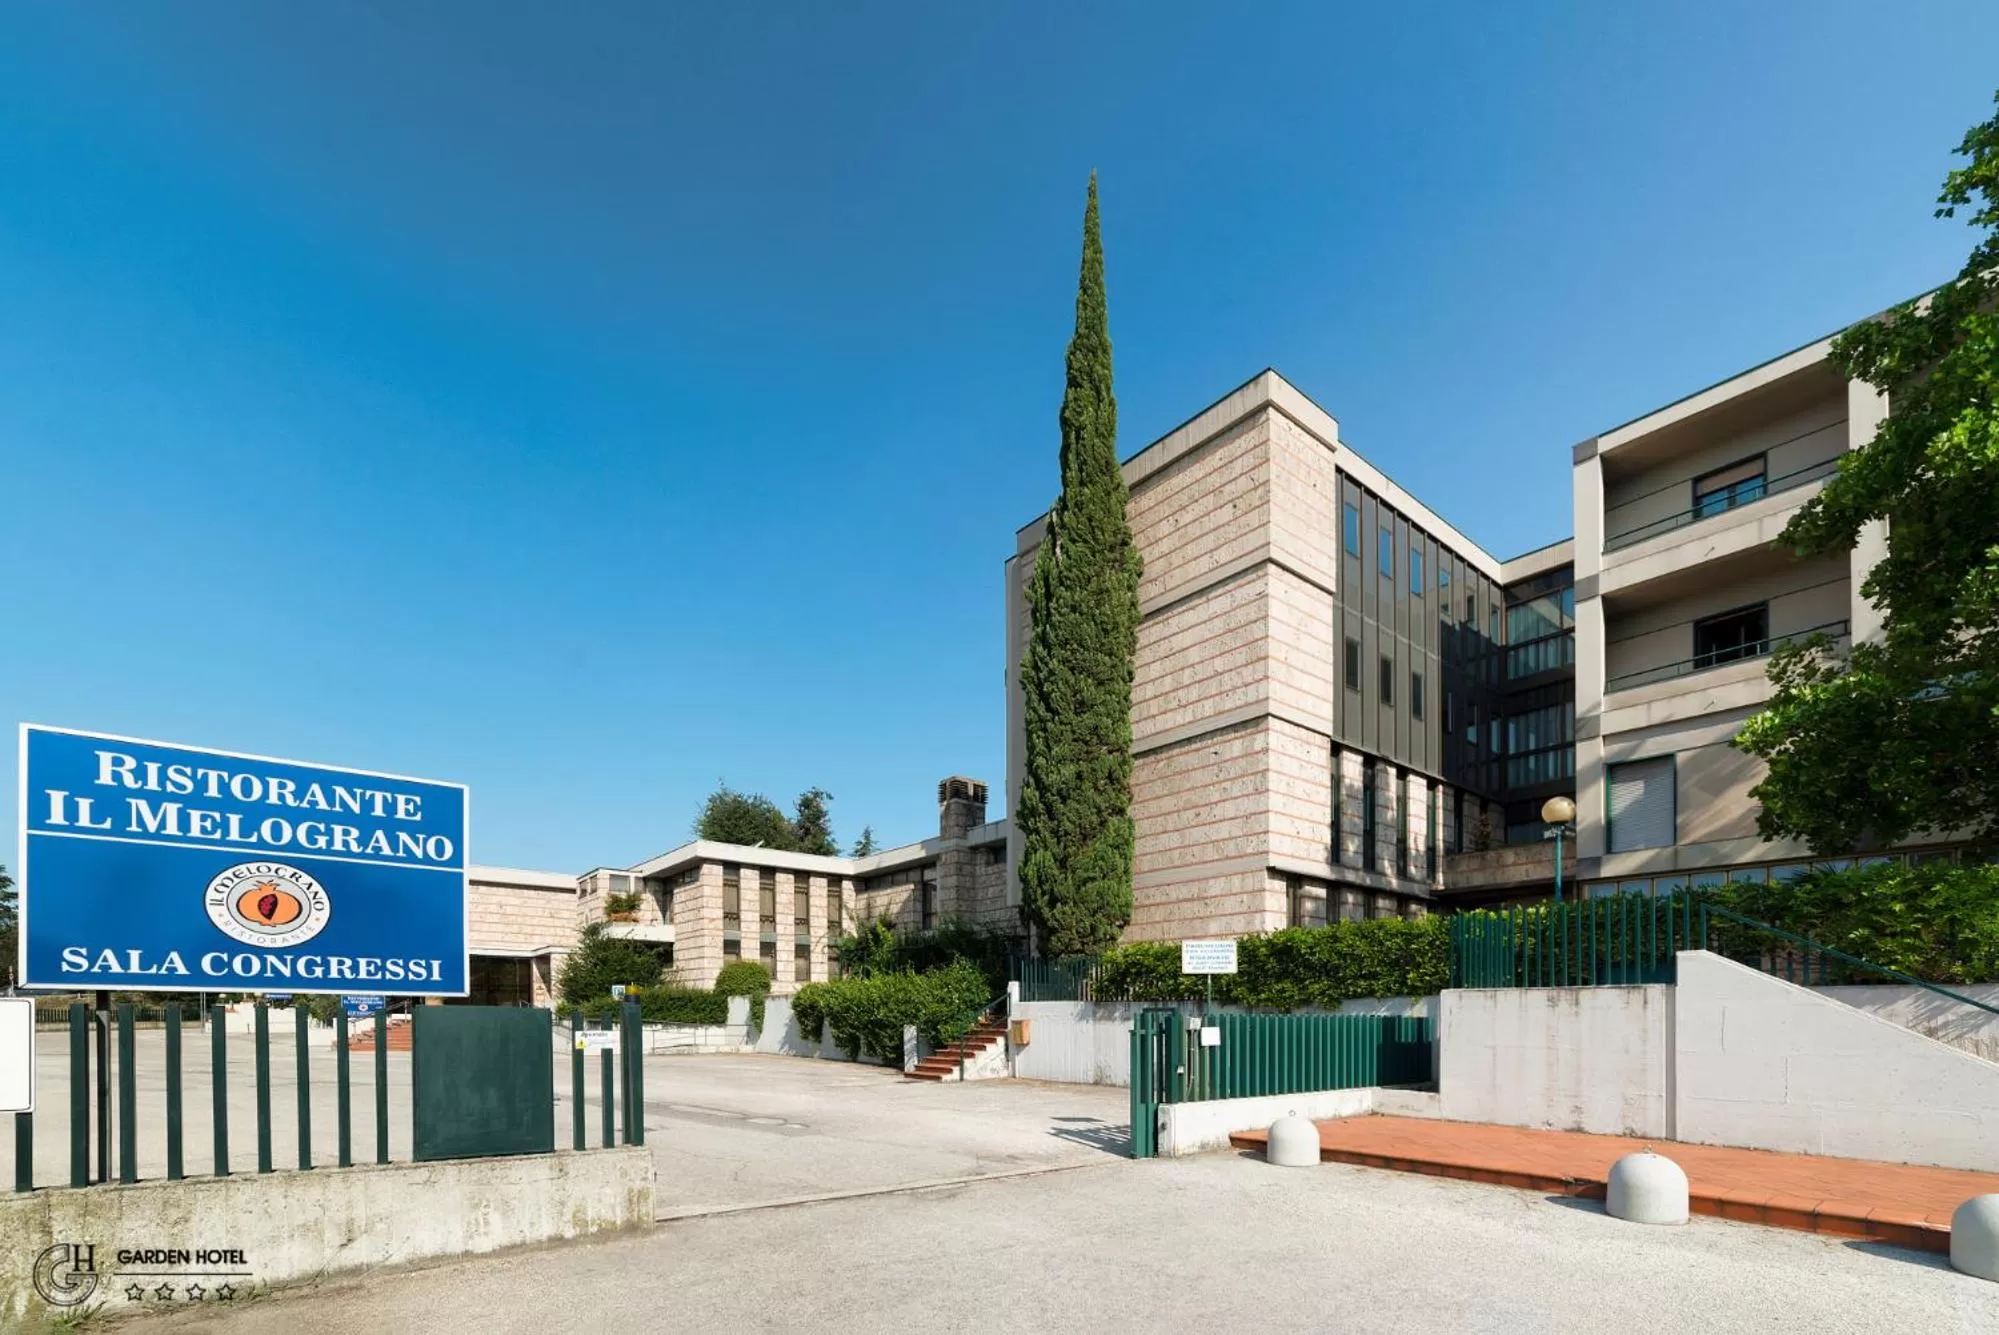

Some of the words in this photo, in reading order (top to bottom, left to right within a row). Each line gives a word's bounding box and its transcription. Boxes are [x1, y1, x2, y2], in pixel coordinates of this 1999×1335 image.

[94, 750, 423, 821] RISTORANTE
[44, 789, 112, 829] IL
[126, 797, 454, 861] MELOGRANO
[61, 947, 190, 976] SALA
[201, 952, 443, 982] CONGRESSI
